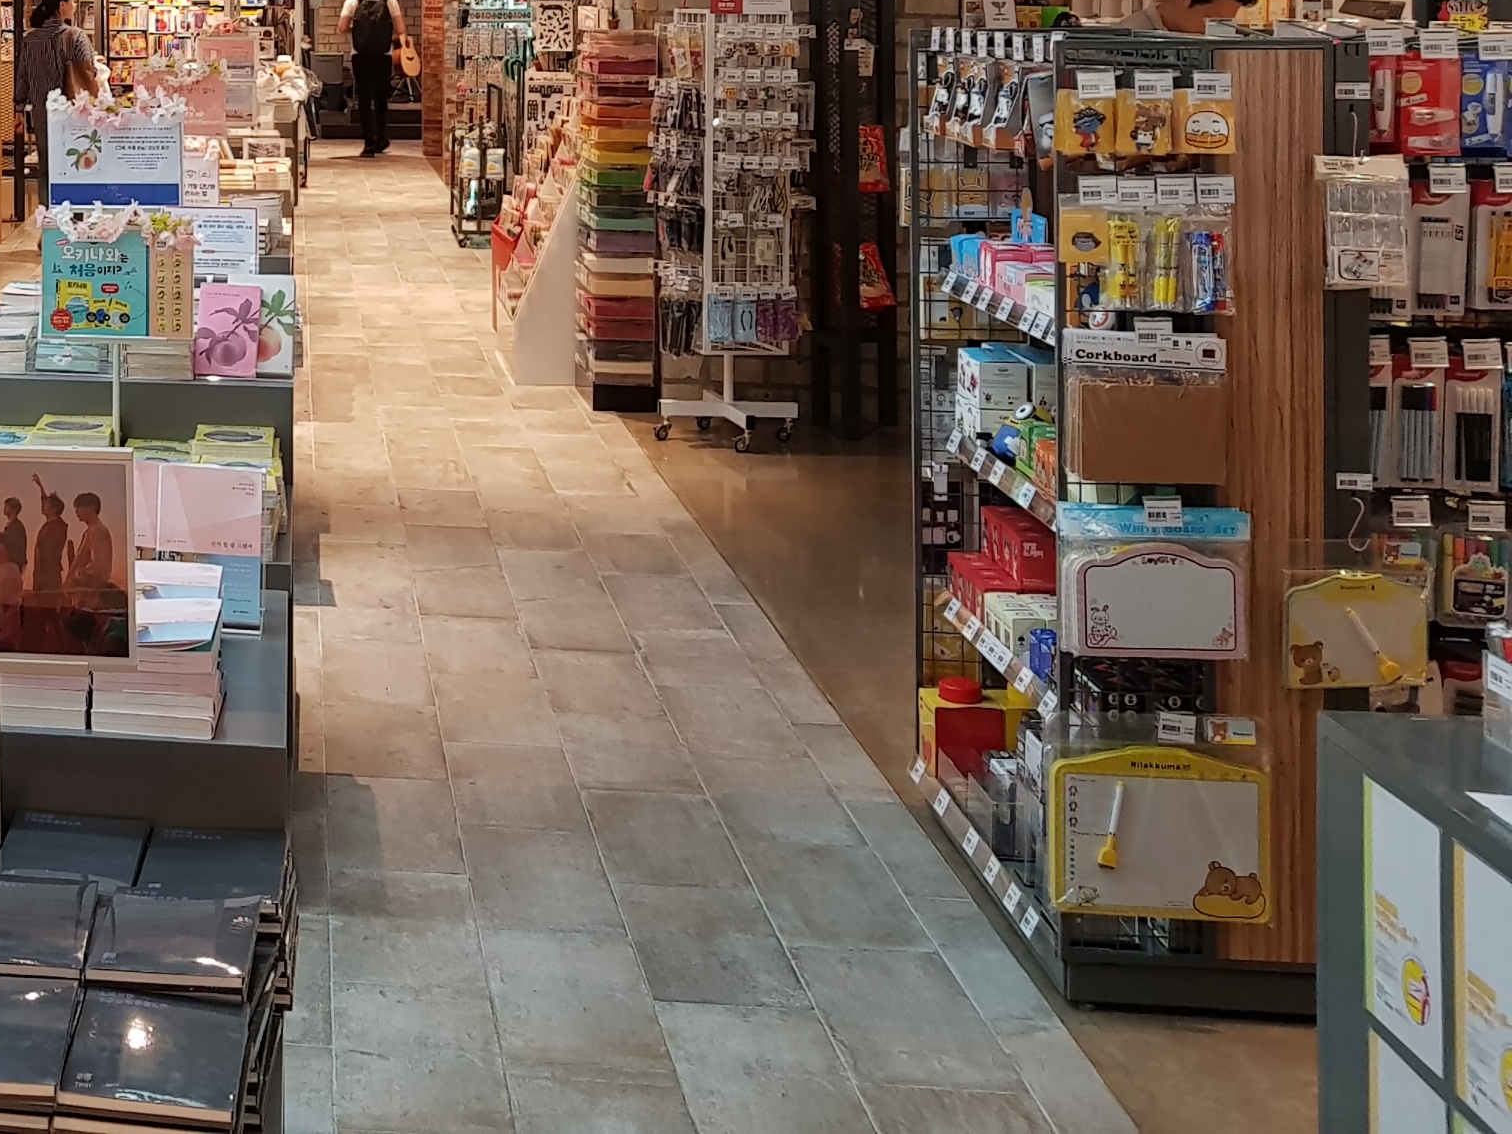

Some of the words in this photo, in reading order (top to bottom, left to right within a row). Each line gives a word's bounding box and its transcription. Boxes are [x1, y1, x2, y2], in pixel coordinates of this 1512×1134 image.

[1455, 225, 1464, 241] 153
[62, 245, 129, 263] 오키나와는
[69, 264, 122, 277] 처음이지?
[1075, 349, 1157, 363] Corkboard
[1130, 761, 1181, 771] Rilakkuma
